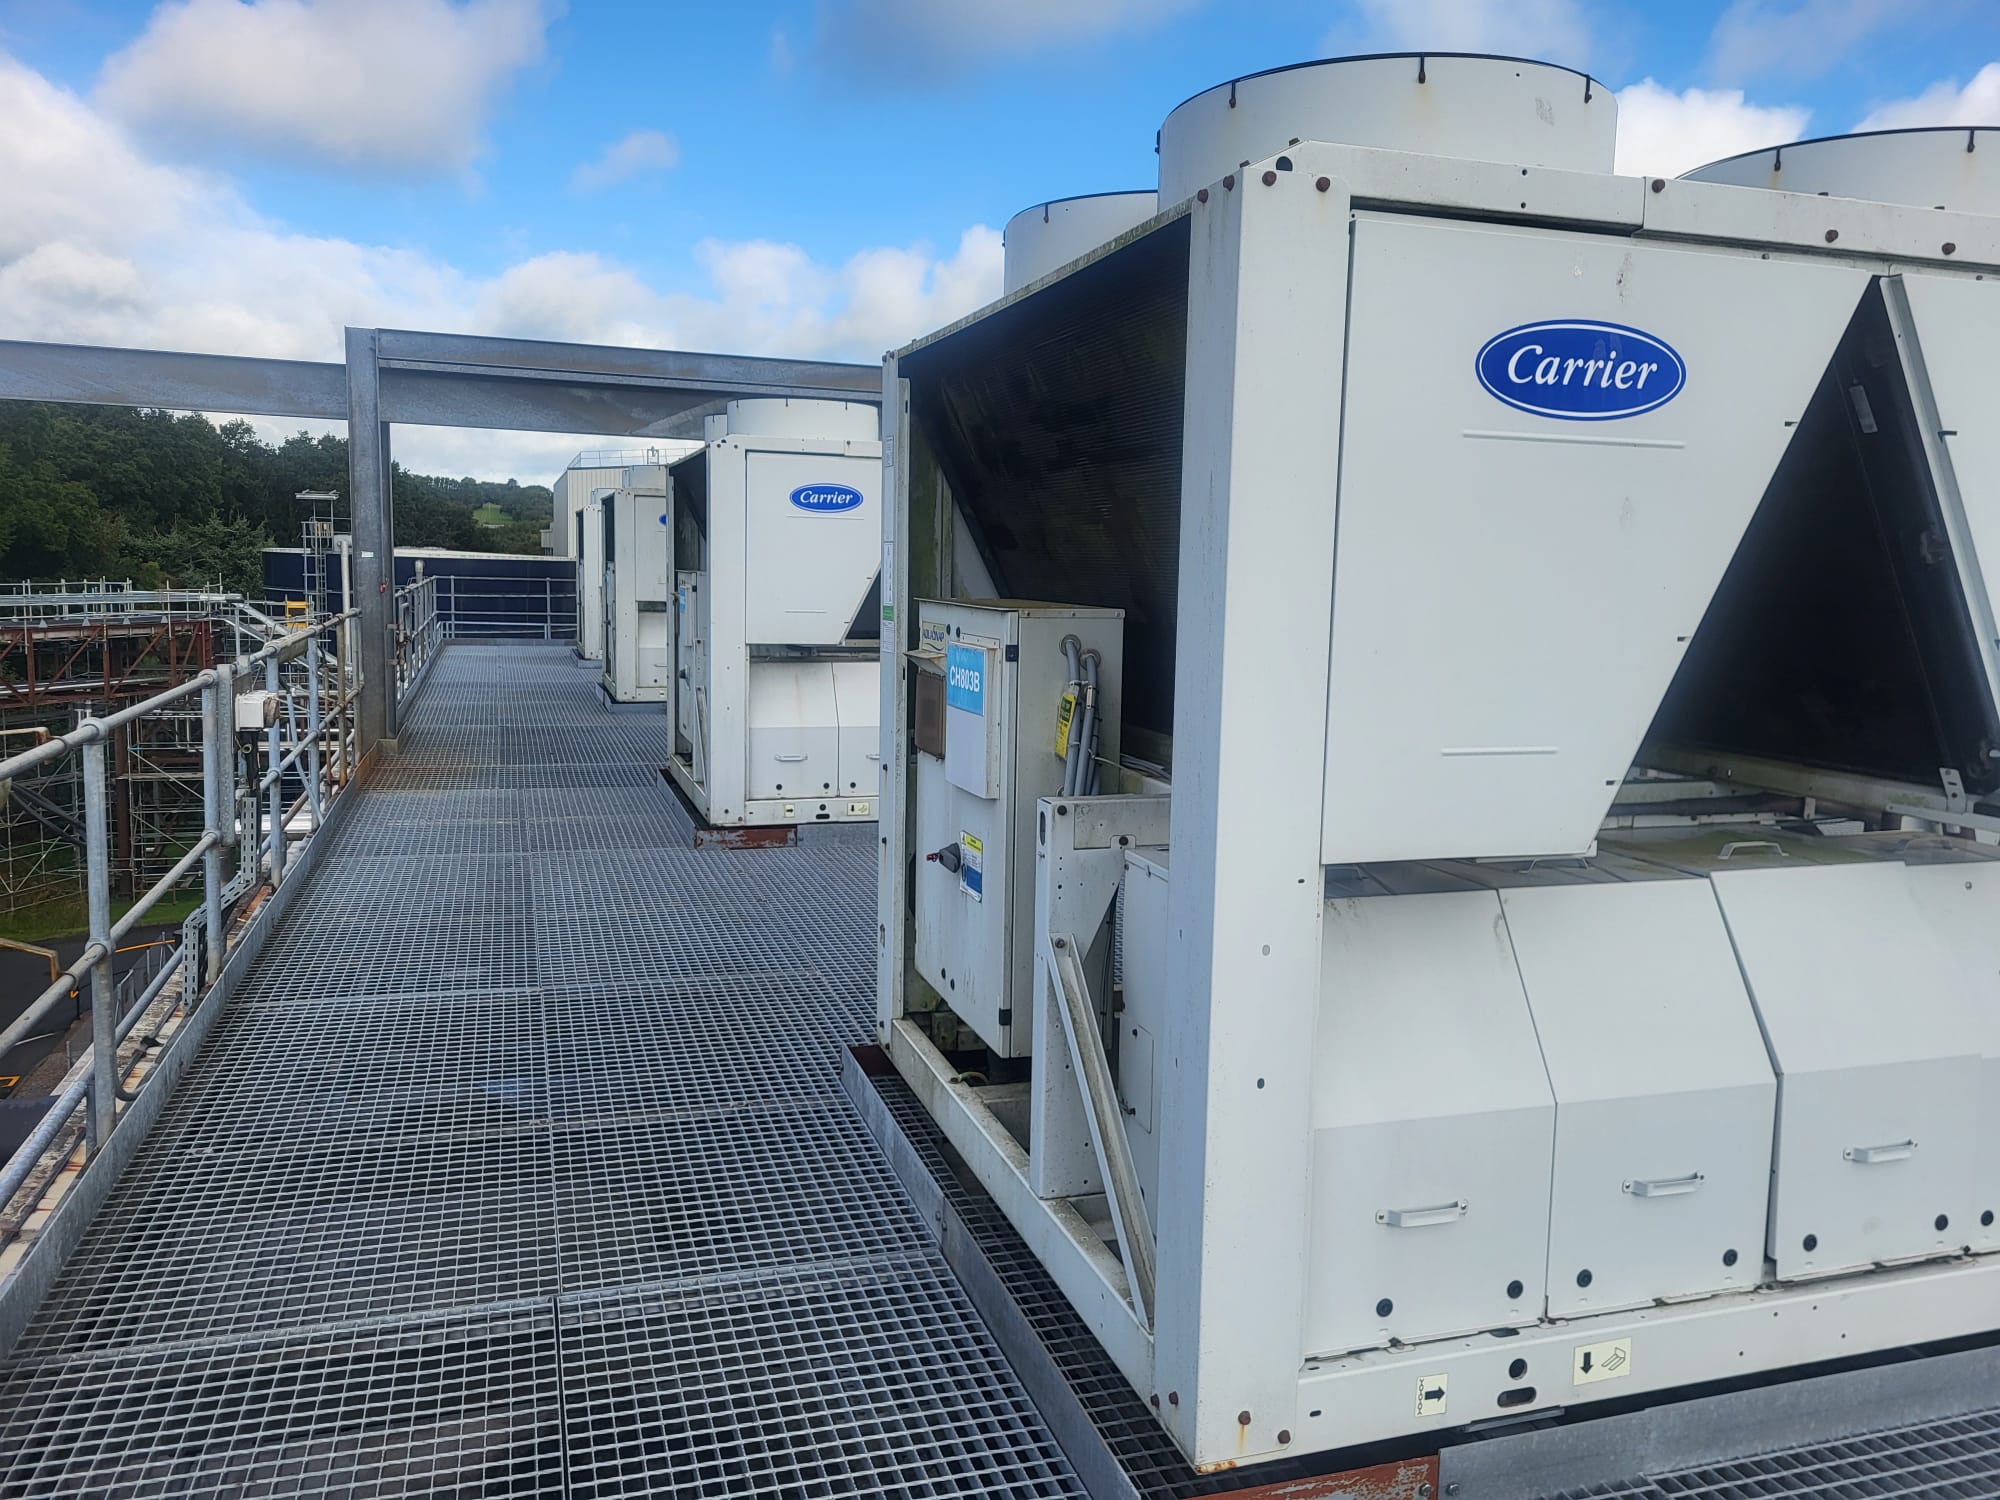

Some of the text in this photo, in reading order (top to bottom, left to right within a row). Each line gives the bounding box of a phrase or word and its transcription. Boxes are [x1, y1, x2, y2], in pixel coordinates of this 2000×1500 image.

[1507, 344, 1658, 390] Carrier
[800, 490, 854, 504] Carrier
[949, 665, 980, 692] CH803B
